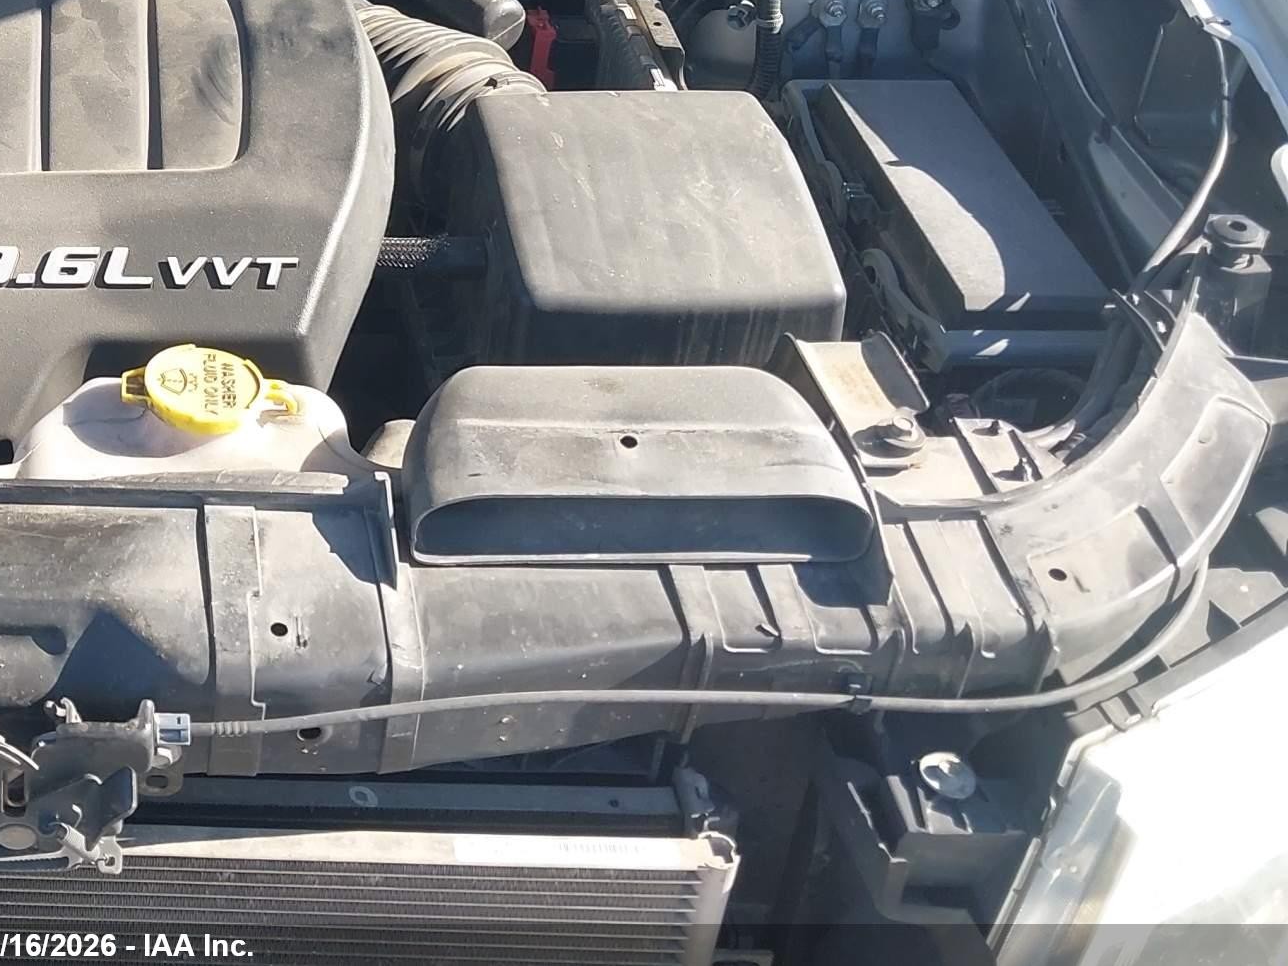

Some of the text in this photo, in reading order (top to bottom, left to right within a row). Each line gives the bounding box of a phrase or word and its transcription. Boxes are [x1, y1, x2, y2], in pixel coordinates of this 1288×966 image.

[160, 256, 299, 289] VVT
[203, 353, 219, 416] FLUID ONLY
[220, 362, 237, 409] WASHER
